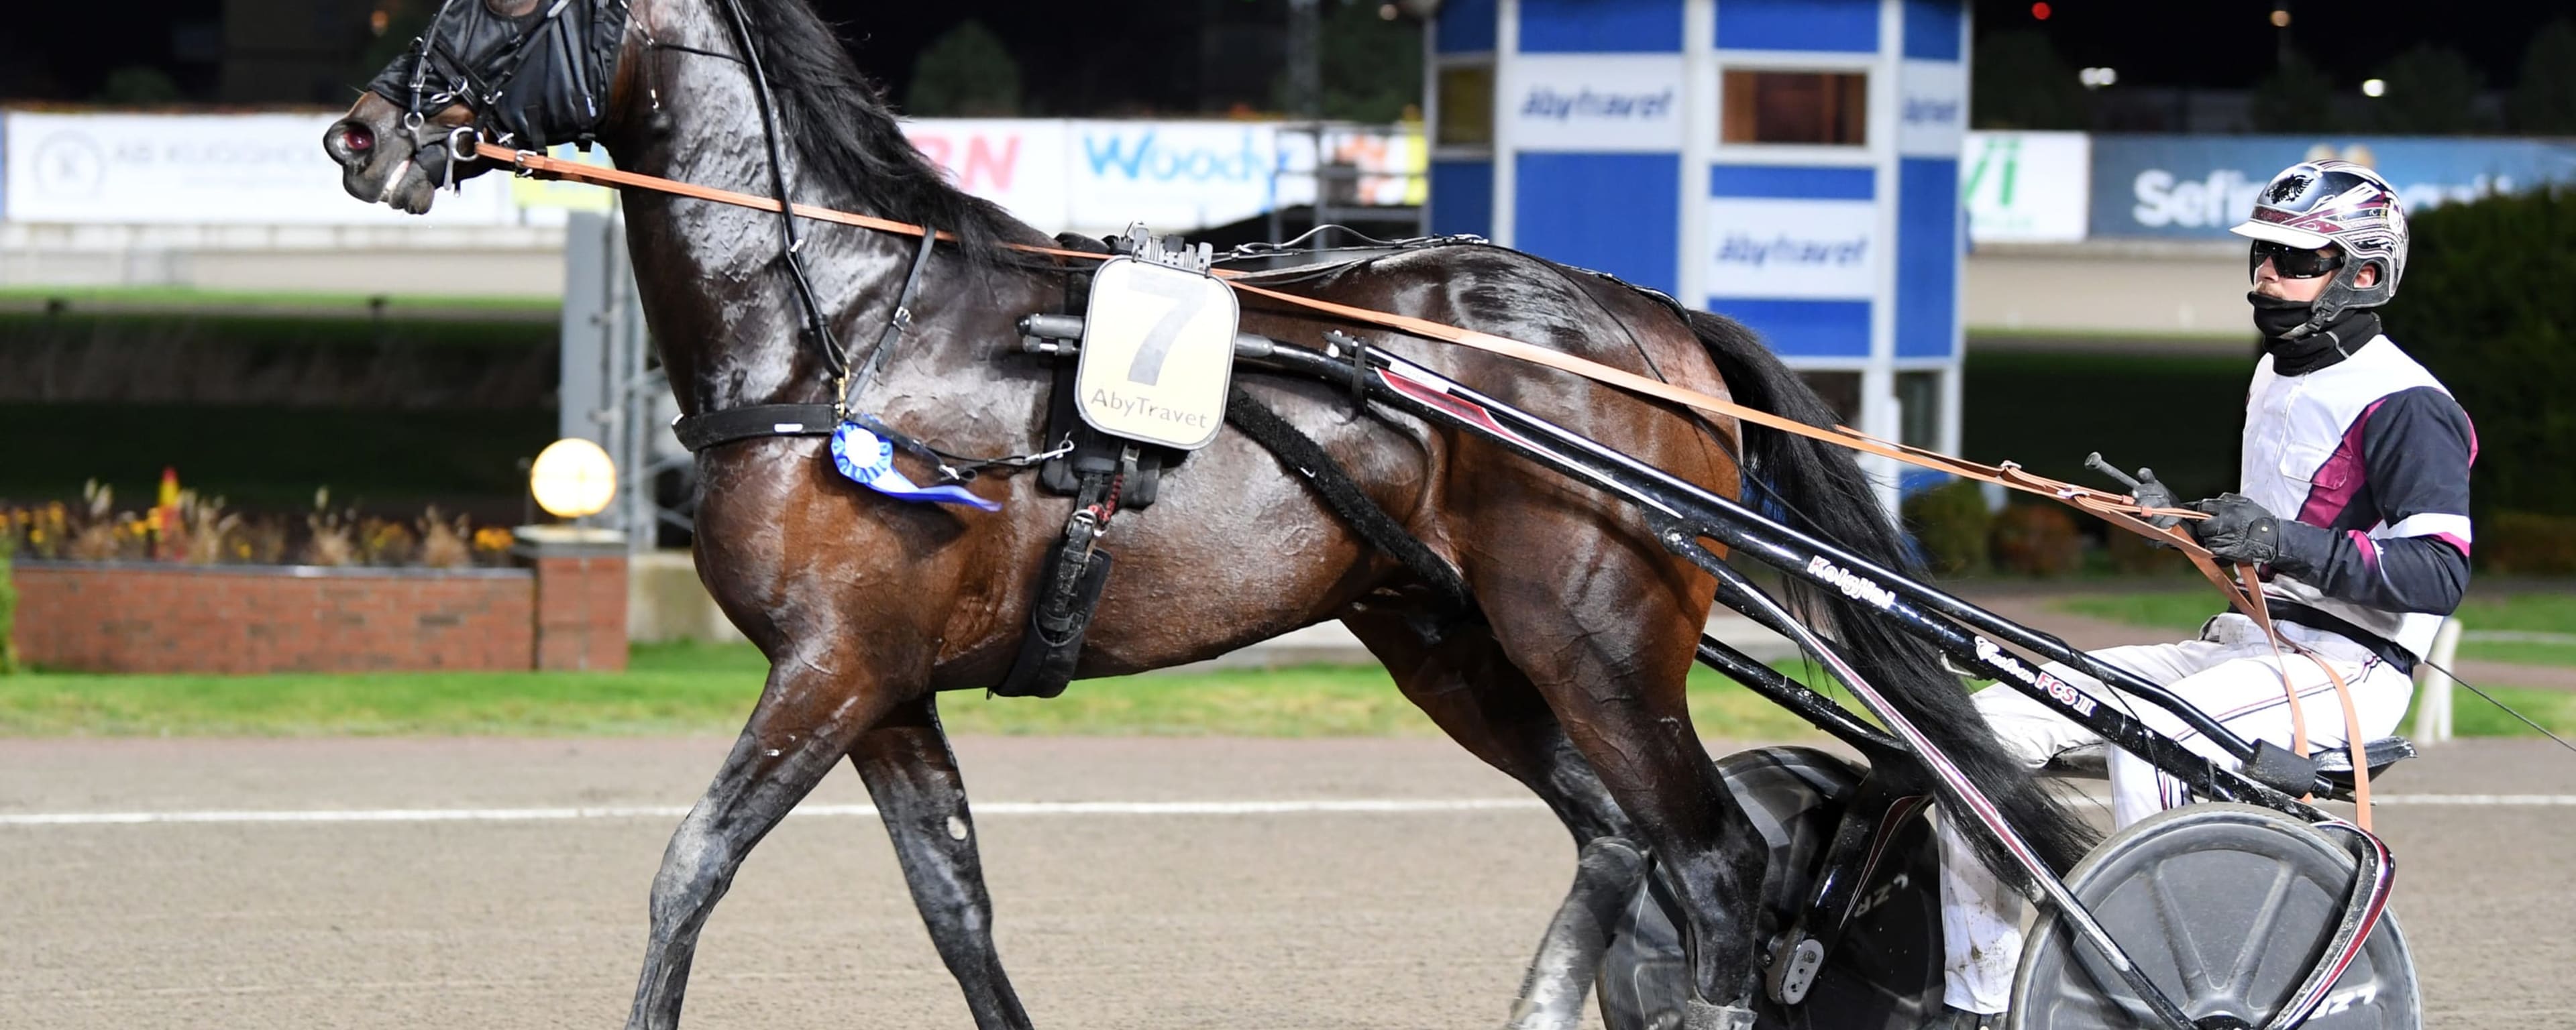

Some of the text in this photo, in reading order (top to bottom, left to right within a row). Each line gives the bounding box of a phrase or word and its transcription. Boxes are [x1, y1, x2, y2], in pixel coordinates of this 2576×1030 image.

[1128, 267, 1208, 387] 7
[1090, 388, 1208, 428] AbyTravet
[2035, 671, 2078, 705] FCS
[1854, 873, 1909, 918] LZR
